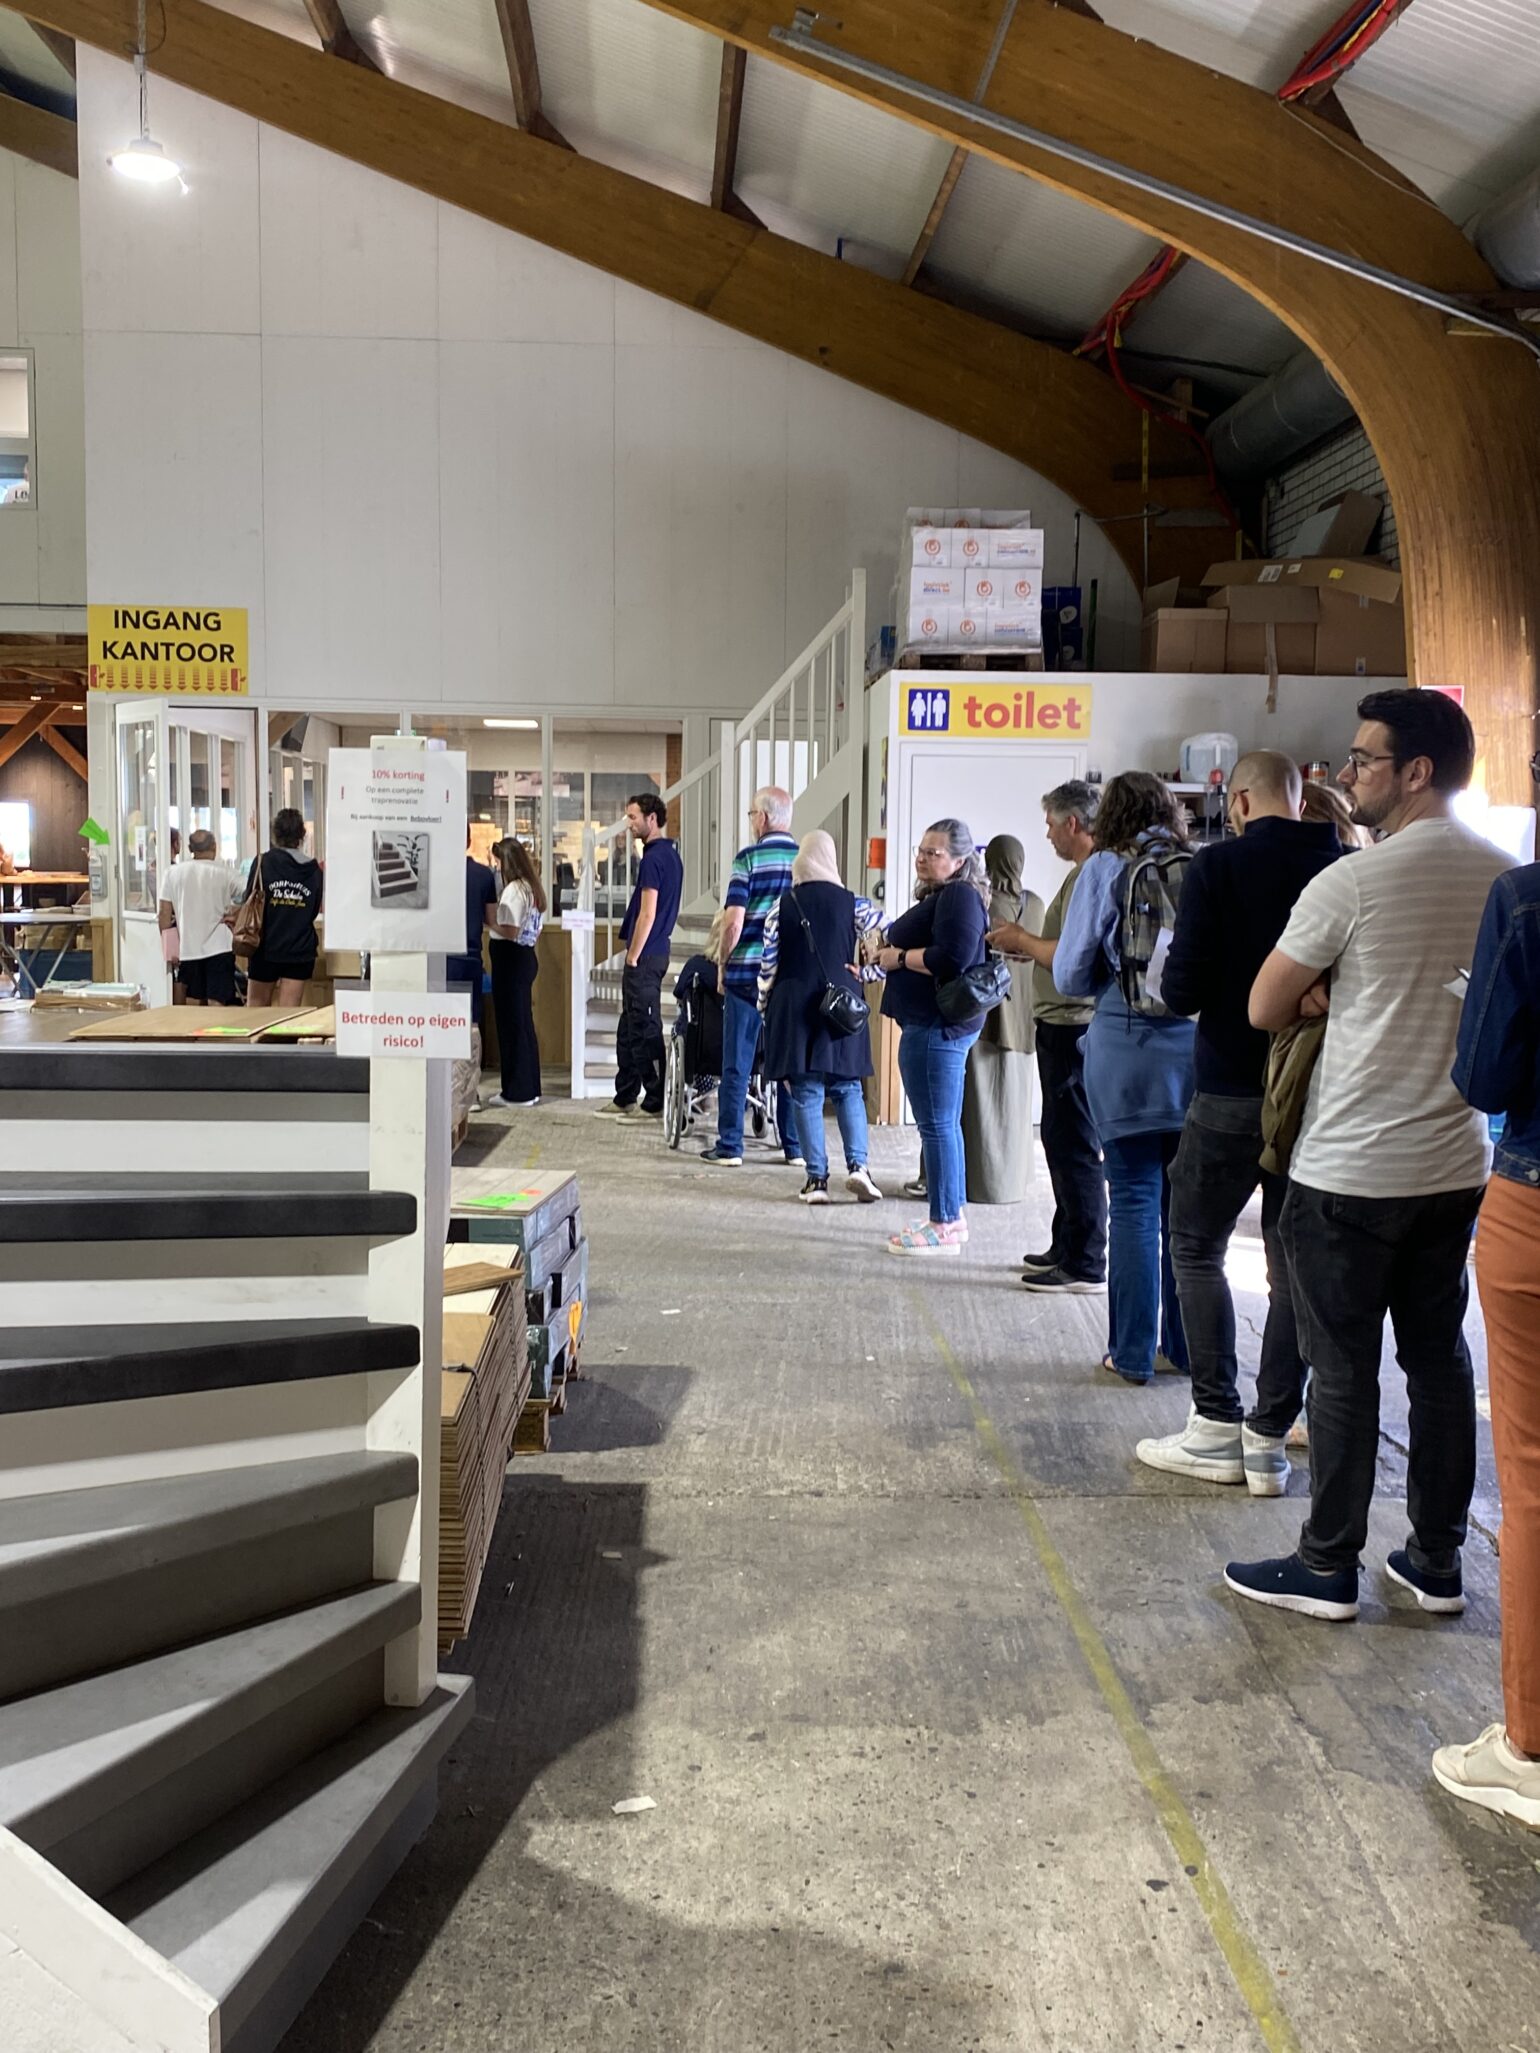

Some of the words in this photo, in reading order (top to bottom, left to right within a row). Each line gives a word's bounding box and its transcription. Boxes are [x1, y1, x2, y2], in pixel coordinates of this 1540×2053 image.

[114, 609, 222, 632] INGANG
[102, 640, 235, 663] KANTOOR
[963, 690, 1082, 729] toilet
[371, 769, 391, 780] 10%
[393, 770, 425, 782] korting
[365, 786, 376, 794] Op
[392, 786, 425, 796] complete
[371, 796, 419, 806] traprenovatie
[341, 1011, 404, 1026] Betreden
[407, 1015, 426, 1029] op
[429, 1013, 467, 1030] eigen
[383, 1034, 425, 1049] risico!
